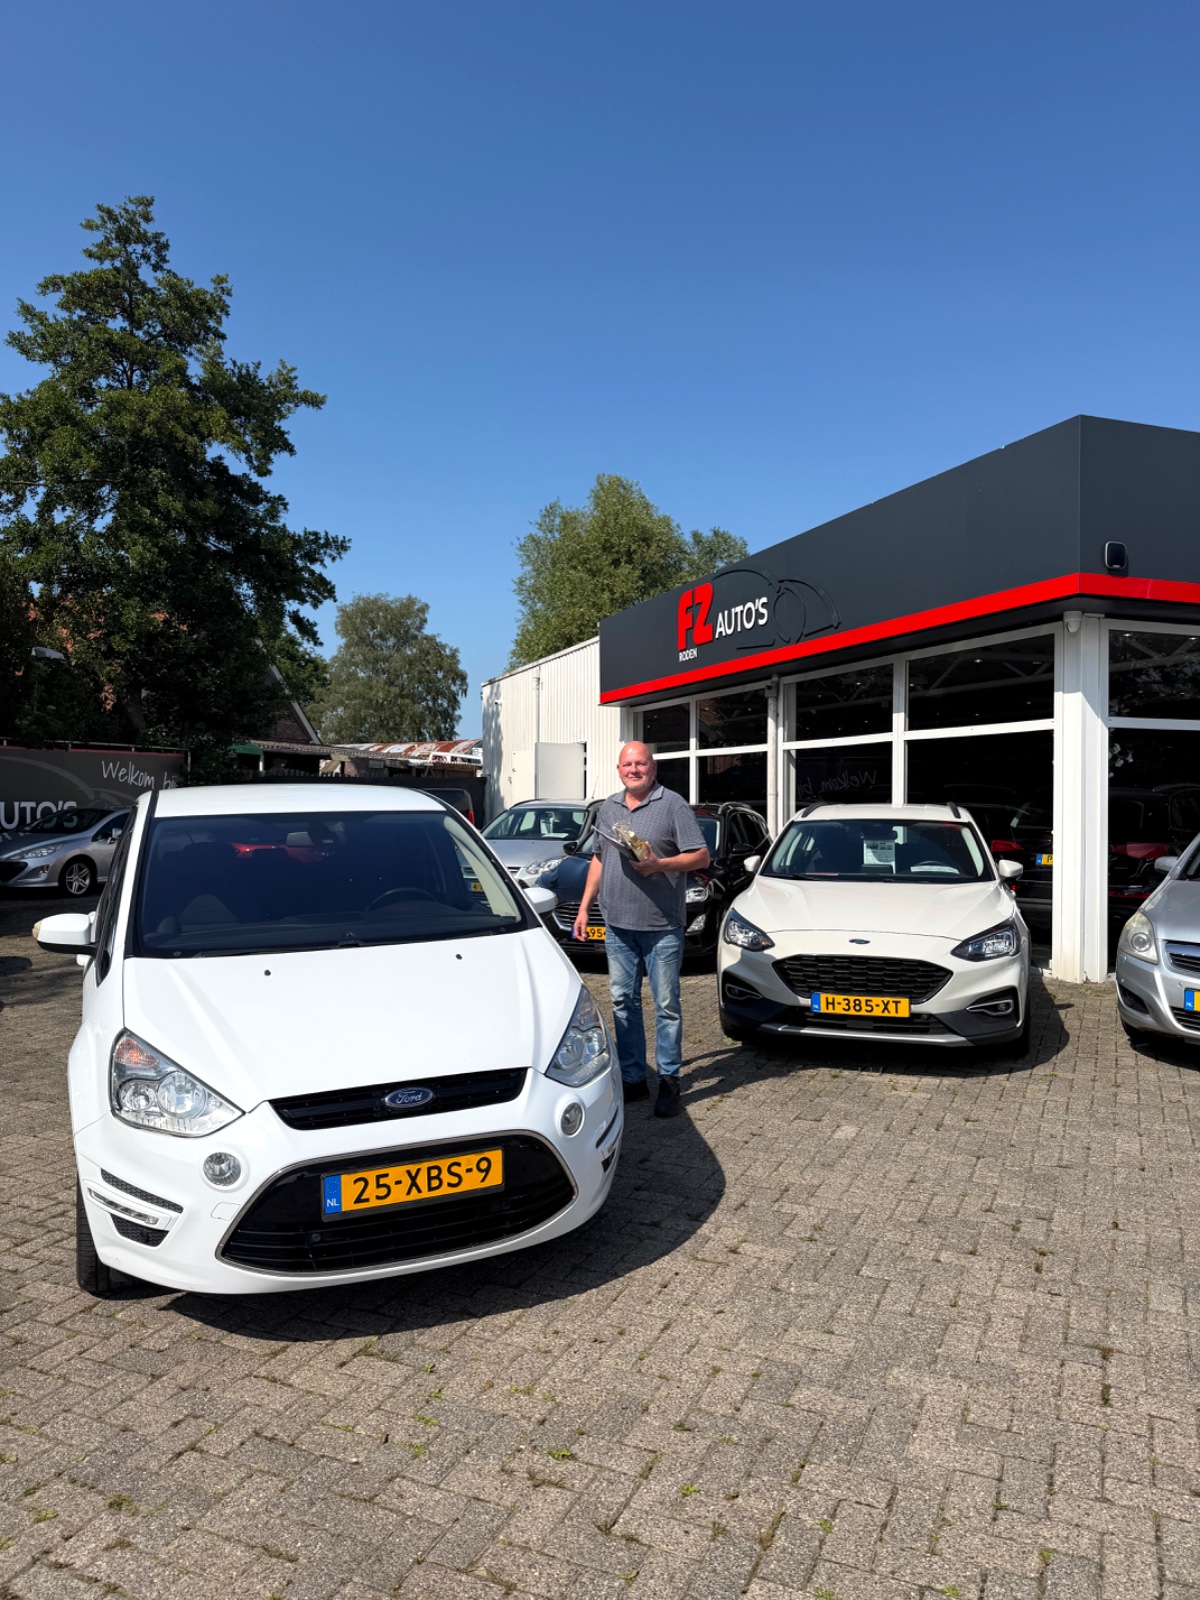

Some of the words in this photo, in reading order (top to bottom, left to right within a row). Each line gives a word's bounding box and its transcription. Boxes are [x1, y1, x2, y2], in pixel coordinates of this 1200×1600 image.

[677, 582, 714, 651] FZ
[715, 596, 769, 639] AUTO'S
[678, 647, 698, 662] RODEN
[101, 760, 155, 789] Welkom
[0, 800, 78, 830] UTO'S
[825, 996, 902, 1014] H-385-XT
[395, 1090, 423, 1104] Ford
[326, 1198, 340, 1207] NL
[352, 1156, 493, 1205] 25-XBS-9
